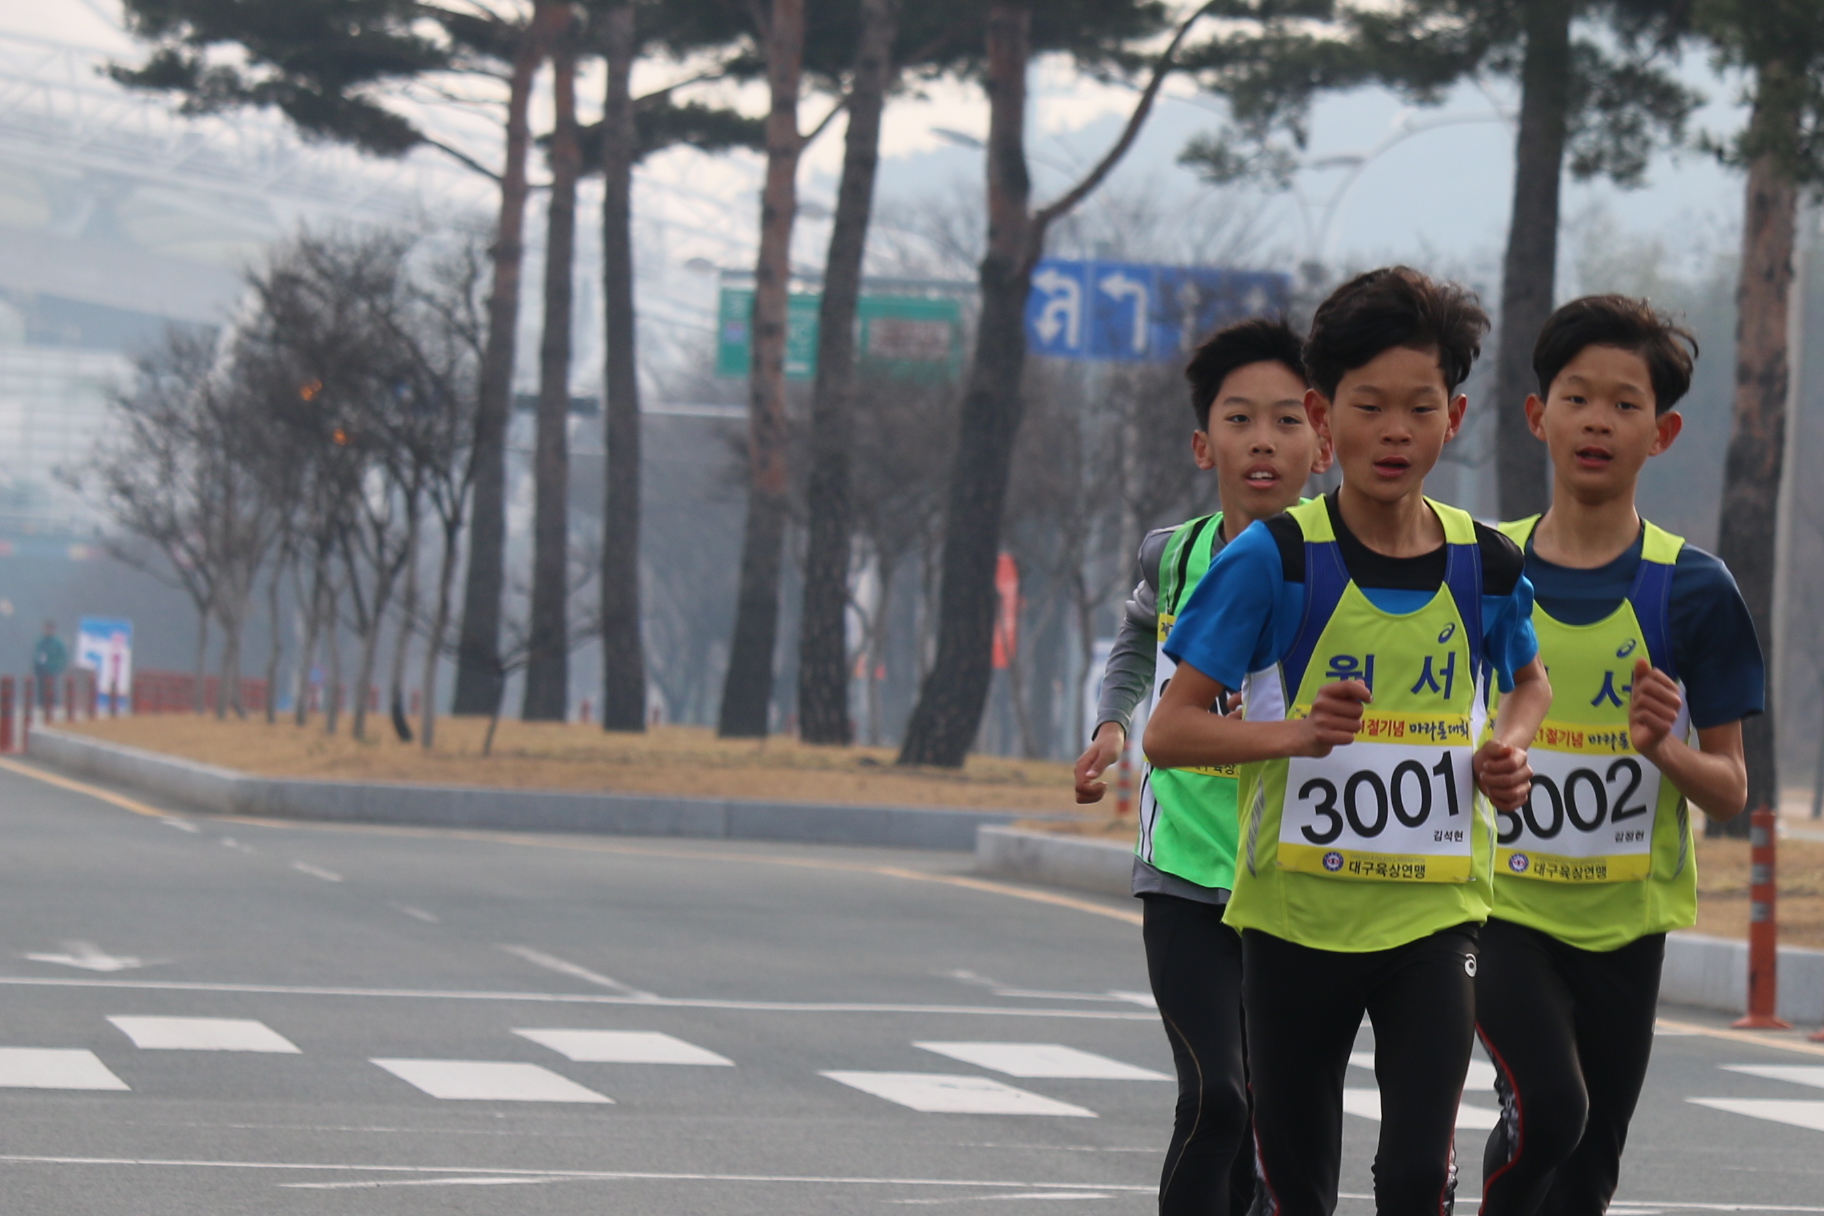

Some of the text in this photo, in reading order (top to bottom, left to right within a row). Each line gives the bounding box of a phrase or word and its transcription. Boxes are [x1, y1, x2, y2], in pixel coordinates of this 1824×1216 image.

[1410, 651, 1456, 700] 서
[1360, 718, 1405, 738] 1절기념
[1588, 731, 1630, 752] 마라톤
[1298, 750, 1459, 845] 3001
[1433, 830, 1463, 842] 김석현
[1349, 860, 1426, 879] 대구육상연맹
